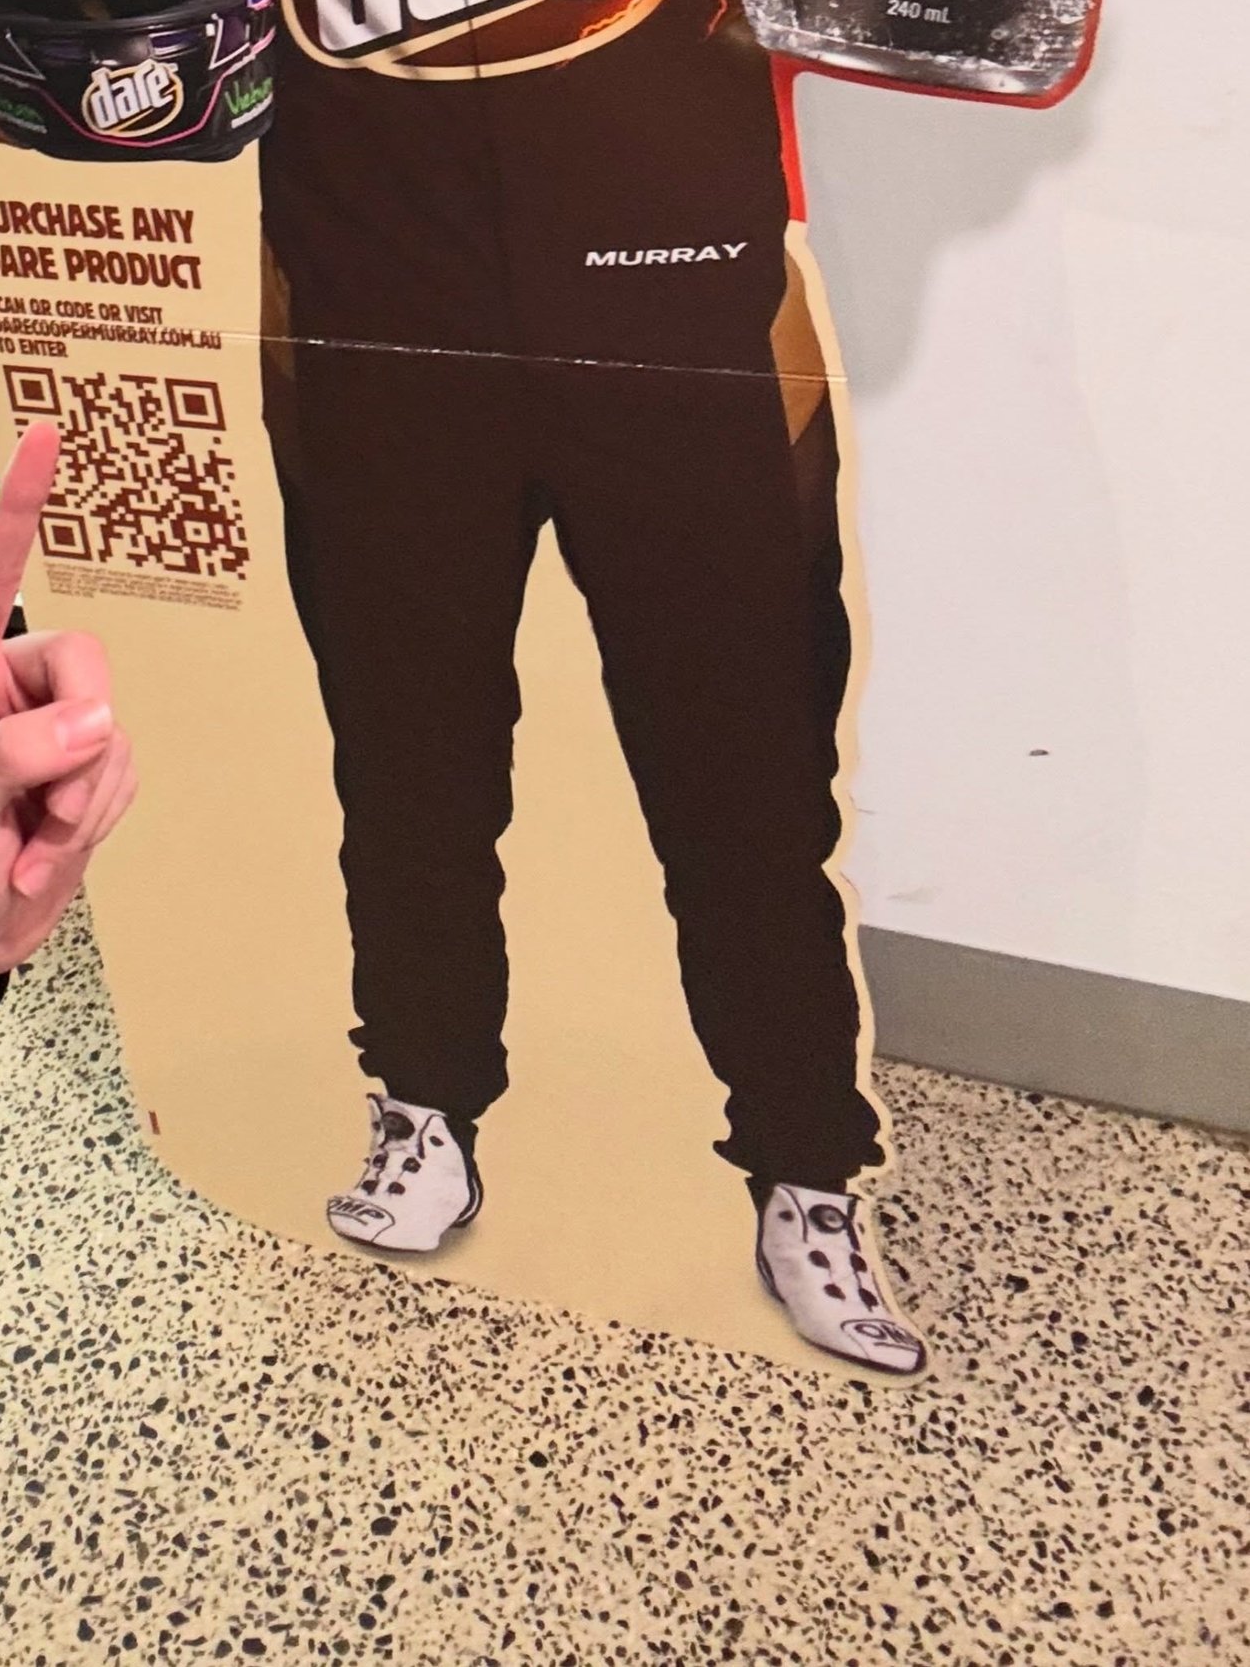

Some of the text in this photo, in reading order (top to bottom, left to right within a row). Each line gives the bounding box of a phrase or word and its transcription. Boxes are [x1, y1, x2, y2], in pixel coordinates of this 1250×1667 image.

[886, 0, 952, 24] 240 mL
[89, 63, 176, 130] dare
[132, 208, 195, 244] ANY
[63, 247, 203, 290] PRODUCT
[584, 243, 749, 268] MURRAY
[30, 298, 52, 319] QR
[56, 300, 95, 320] CODE
[100, 303, 121, 321] OR
[125, 305, 163, 325] VISIT
[19, 339, 69, 359] ENTER
